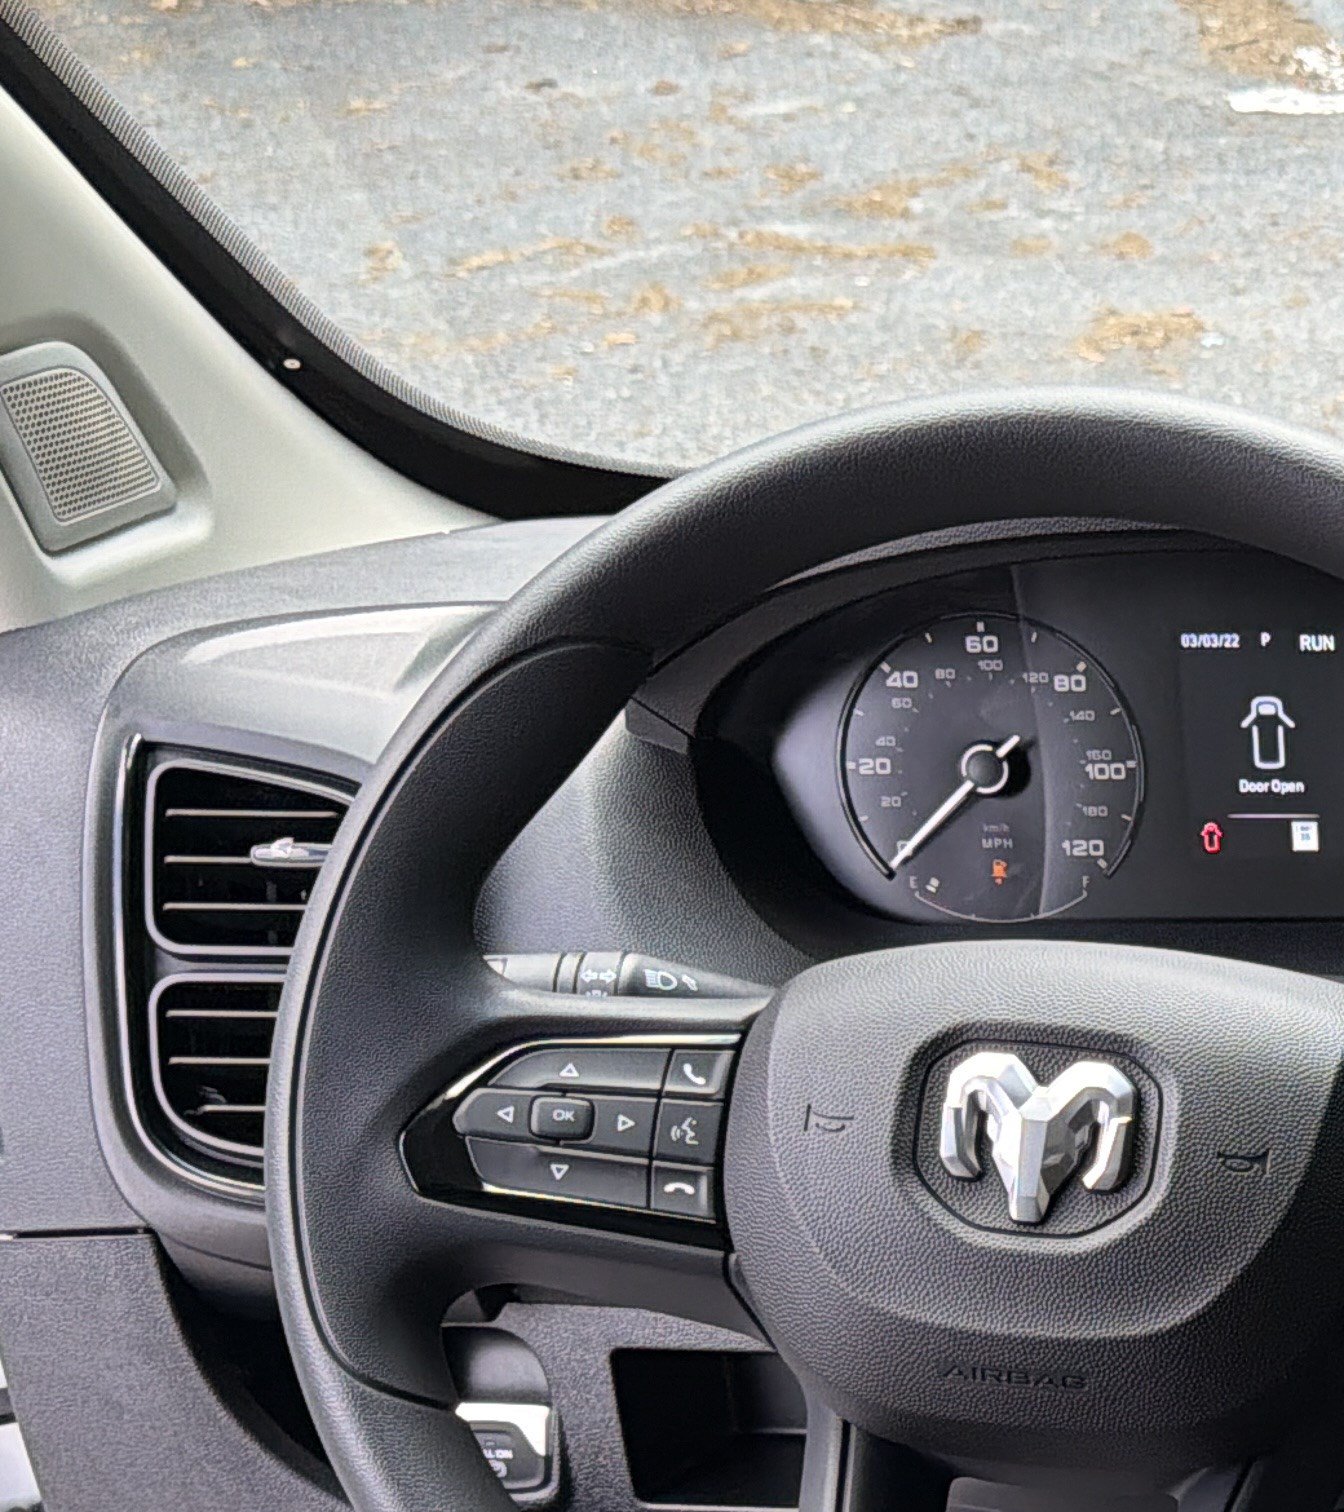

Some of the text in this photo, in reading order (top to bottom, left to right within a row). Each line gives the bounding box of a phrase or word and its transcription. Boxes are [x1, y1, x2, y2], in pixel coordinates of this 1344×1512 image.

[965, 635, 999, 653] 60
[1180, 632, 1336, 652] 03/03/22 P RUN
[977, 659, 1003, 671] 100
[885, 670, 919, 689] 40
[1022, 672, 1049, 684] 120
[1053, 674, 1087, 692] 80
[1069, 710, 1096, 722] 140
[875, 736, 896, 747] 40
[858, 757, 892, 776] 20
[1084, 762, 1127, 781] 100
[1239, 778, 1305, 795] Door Open
[880, 795, 902, 808] 20
[982, 837, 1014, 850] MPH
[1061, 839, 1105, 857] 120
[909, 876, 918, 889] E
[1082, 875, 1091, 889] F
[552, 1108, 576, 1123] OK
[942, 1365, 1088, 1389] AIRBAG
